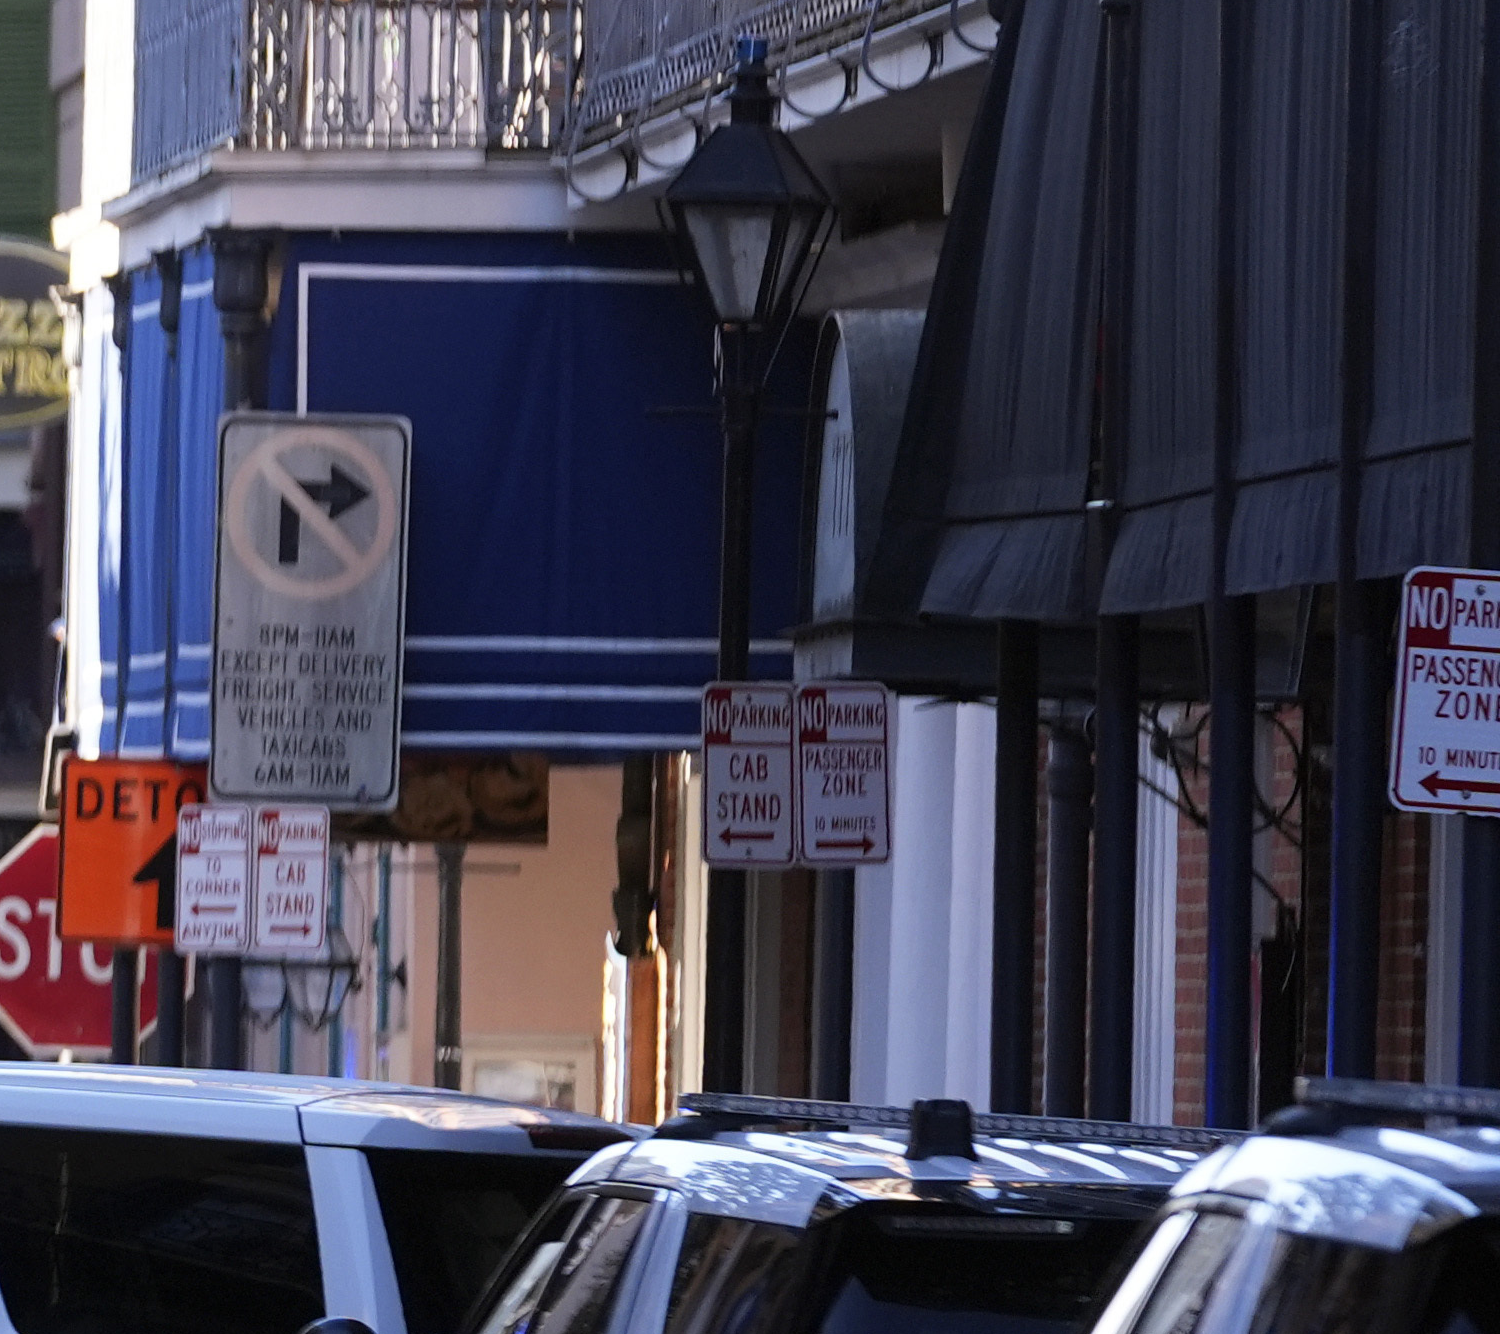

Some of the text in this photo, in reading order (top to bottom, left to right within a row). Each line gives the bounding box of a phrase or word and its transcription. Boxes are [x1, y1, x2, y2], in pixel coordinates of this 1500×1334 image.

[1408, 585, 1450, 630] NO
[221, 648, 288, 675] EXCEPT
[312, 680, 389, 706] SERVICE
[238, 705, 372, 732] VEHICLES AND
[706, 695, 790, 734] NO PARKING
[801, 695, 884, 733] NO PARKING
[729, 752, 769, 782] CAB
[805, 746, 883, 773] PASSENGER
[1418, 745, 1500, 771] 10 MINUT
[821, 772, 868, 798] ZONE
[717, 792, 782, 824] STAND
[181, 818, 200, 850] NO
[259, 817, 324, 849] NO PARKING
[276, 860, 306, 886] CAB
[185, 878, 241, 896] CORNER
[266, 892, 315, 917] STAND
